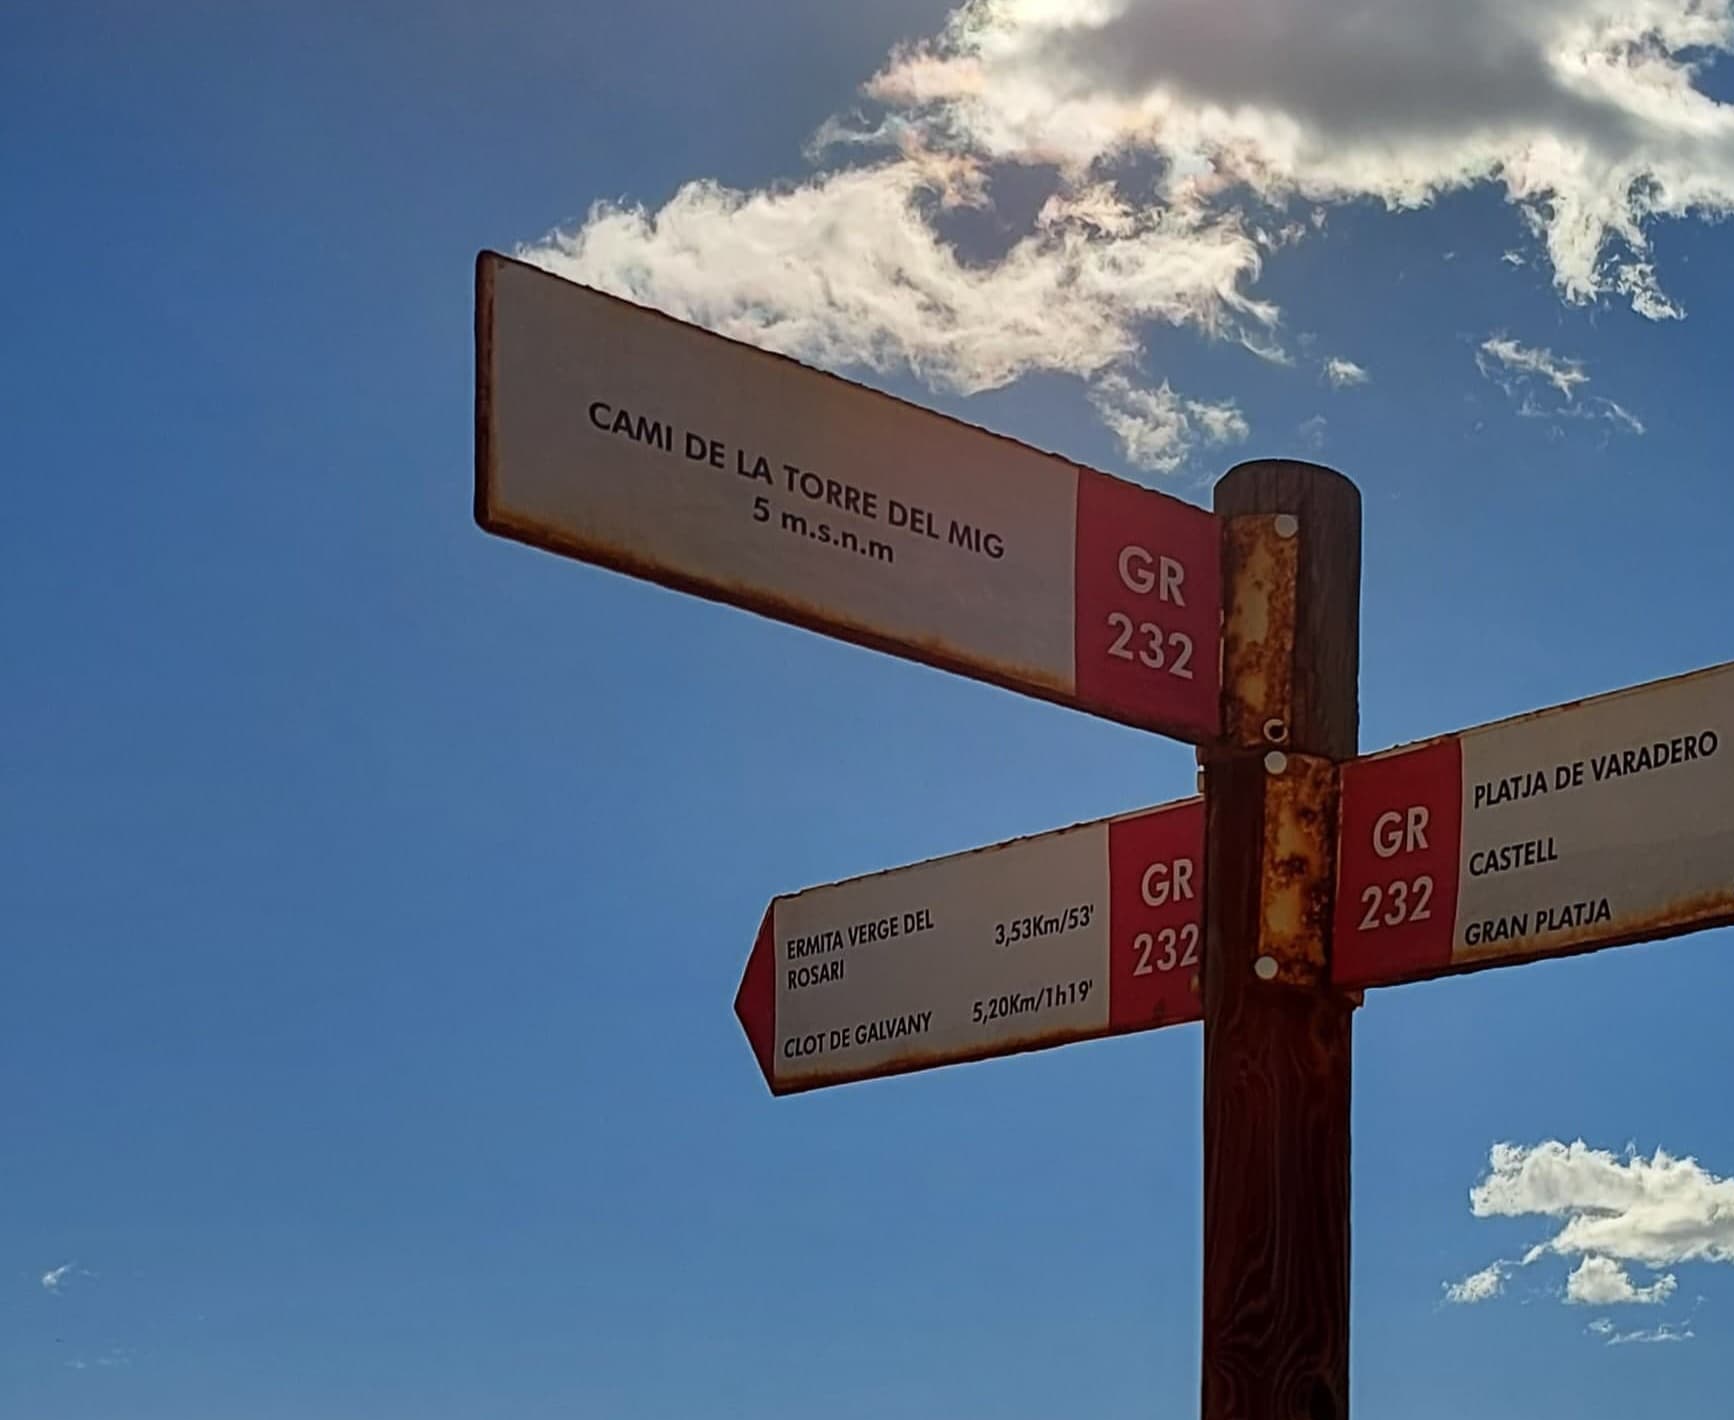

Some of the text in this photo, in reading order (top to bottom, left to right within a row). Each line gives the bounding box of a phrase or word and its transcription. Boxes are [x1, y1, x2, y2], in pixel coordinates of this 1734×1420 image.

[588, 402, 1005, 559] CAMI DE LA TORRE DEL MIG
[752, 496, 894, 564] 5 m.s.n.m
[1118, 544, 1186, 606] GR
[1107, 612, 1194, 680] 232
[1474, 731, 1718, 809] PLATJA DE VARADERO
[1372, 806, 1428, 858] GR
[1469, 838, 1558, 877] CASTELL
[1142, 858, 1194, 907] GR
[1359, 876, 1432, 930] 232
[787, 909, 934, 960] ERMITA VERGE DEL
[995, 904, 1094, 947] 3,53Km/53'
[1464, 898, 1612, 946] GRAN PLATJA
[788, 960, 844, 990] ROSARI
[1133, 923, 1199, 976] 232
[973, 979, 1093, 1024] 5,20Km/1h19'
[784, 1011, 932, 1059] CLOT DE GALVANY
